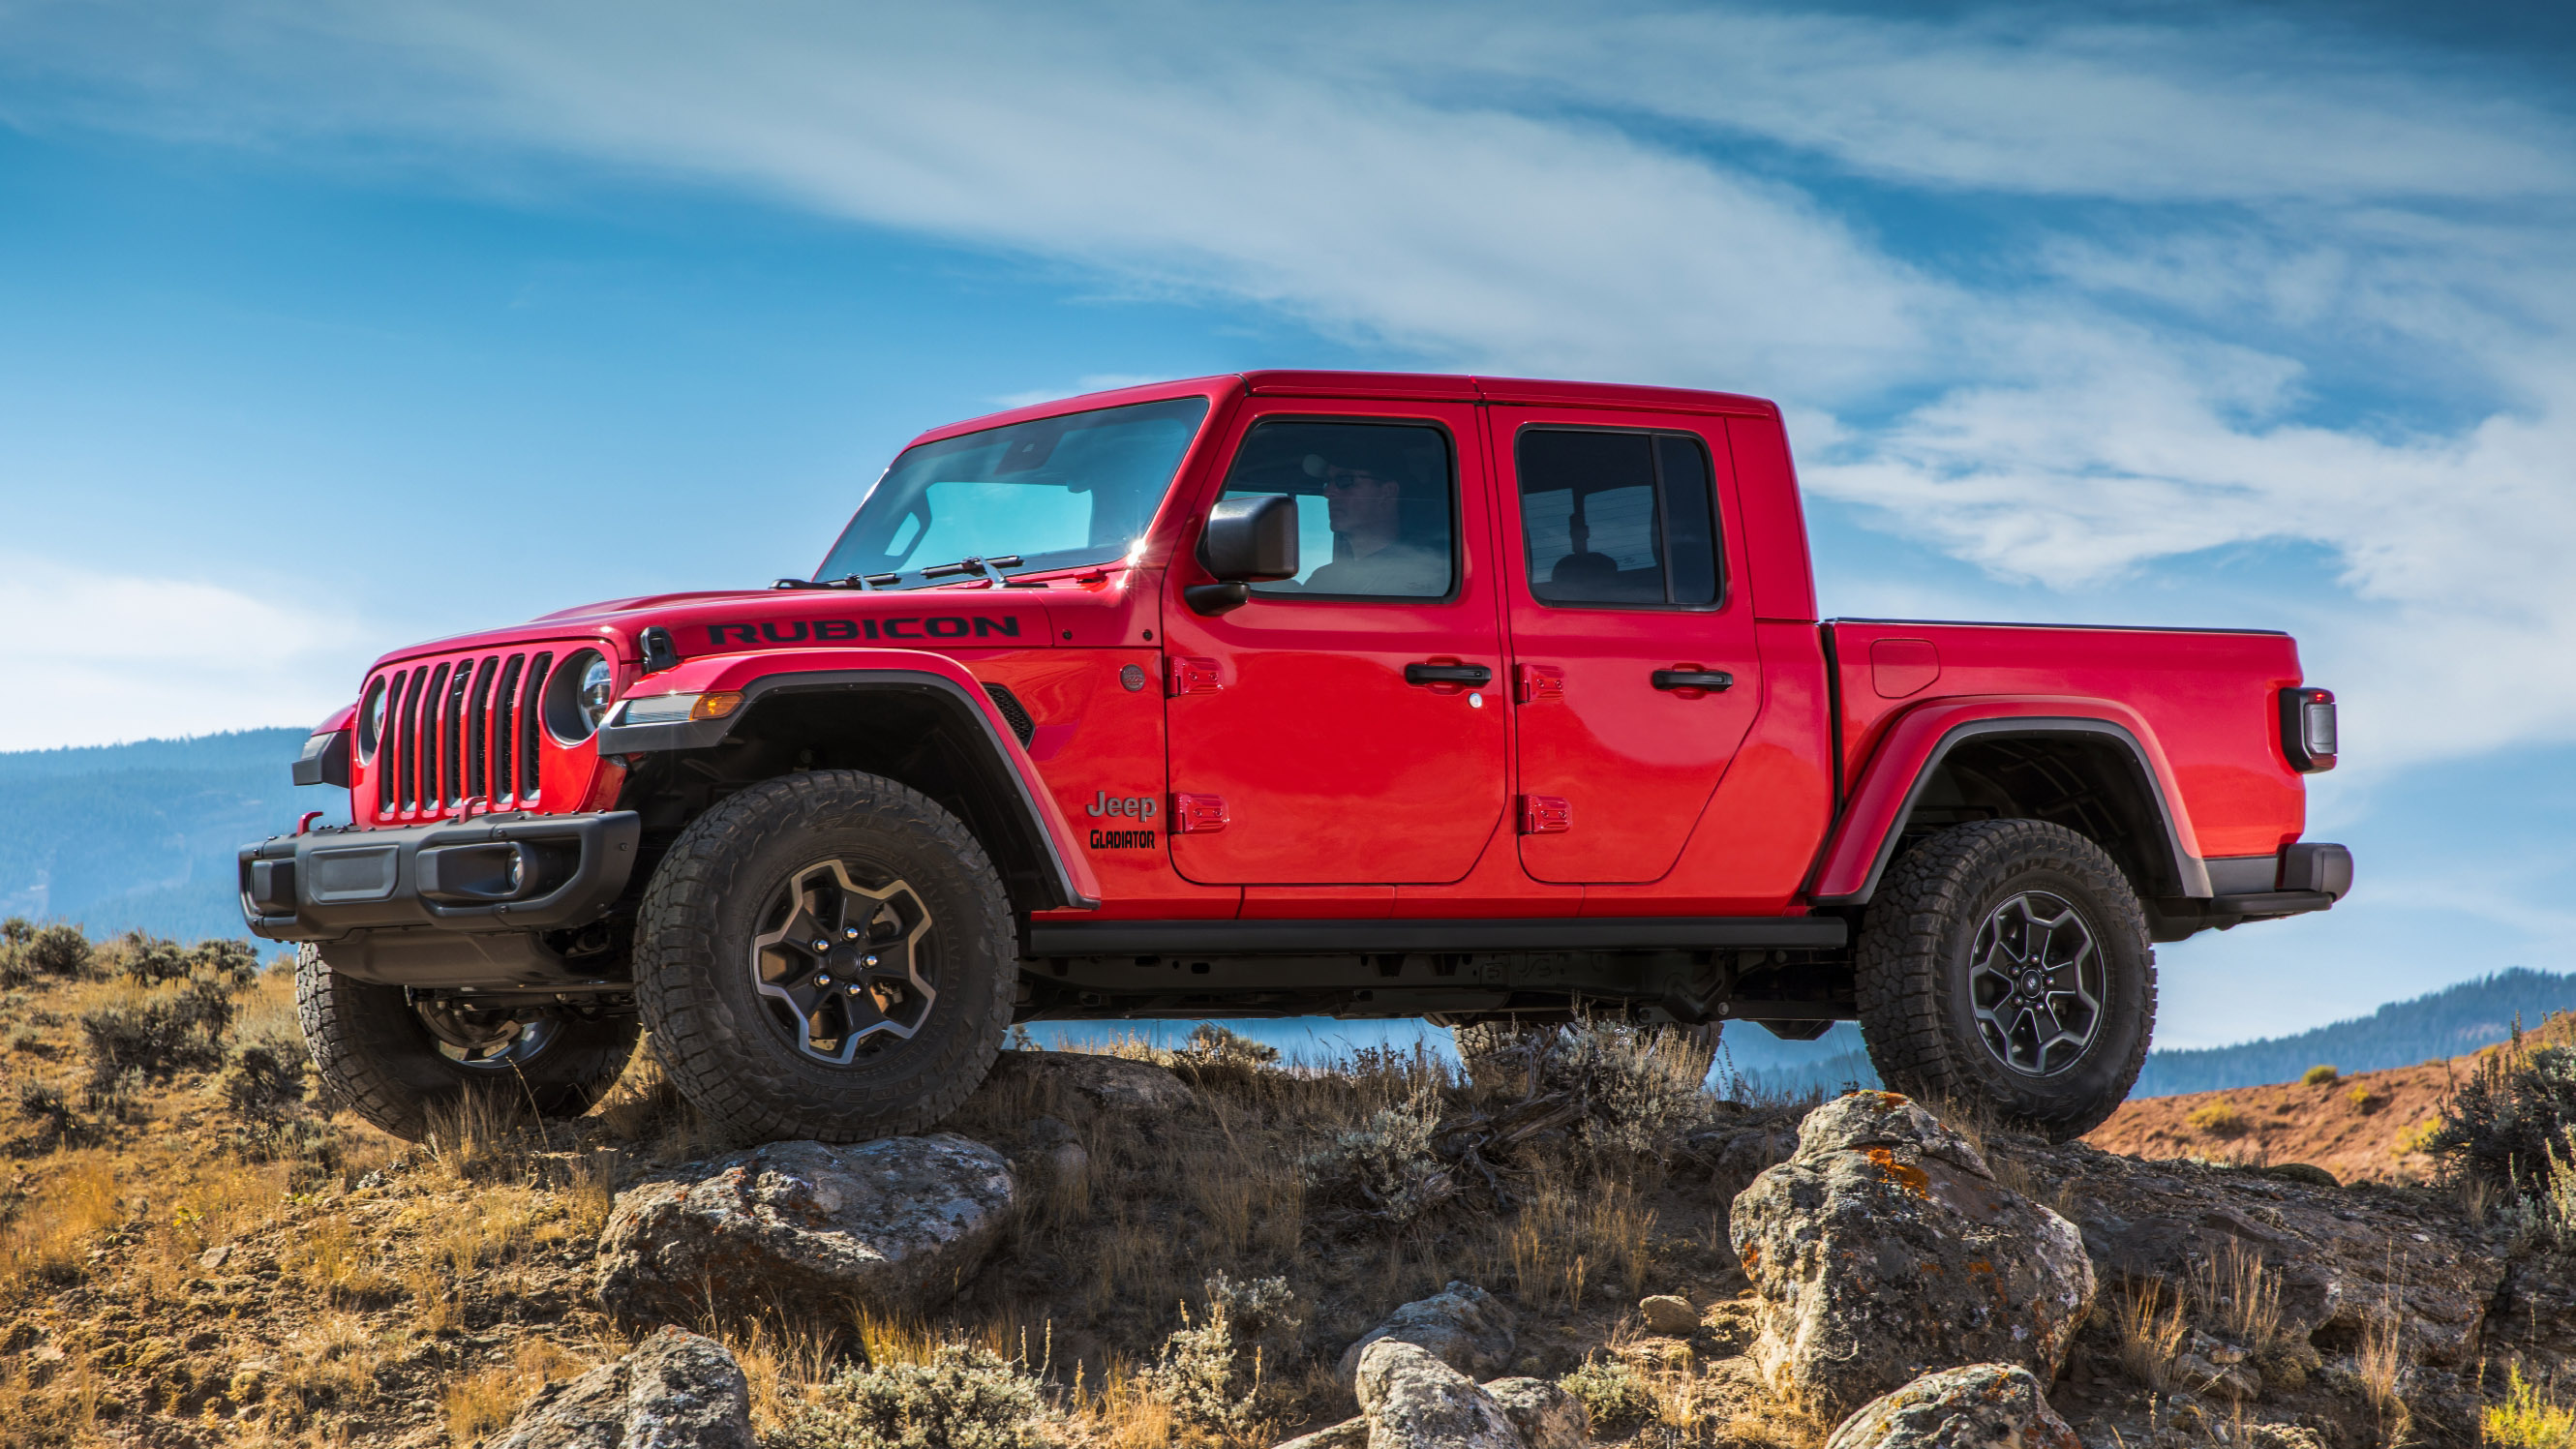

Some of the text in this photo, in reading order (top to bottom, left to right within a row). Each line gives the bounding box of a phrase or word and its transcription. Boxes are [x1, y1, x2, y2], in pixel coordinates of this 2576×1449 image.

[707, 616, 1021, 646] RUBICON
[1086, 790, 1156, 823] Jeep
[1090, 829, 1155, 849] GLADIATOR
